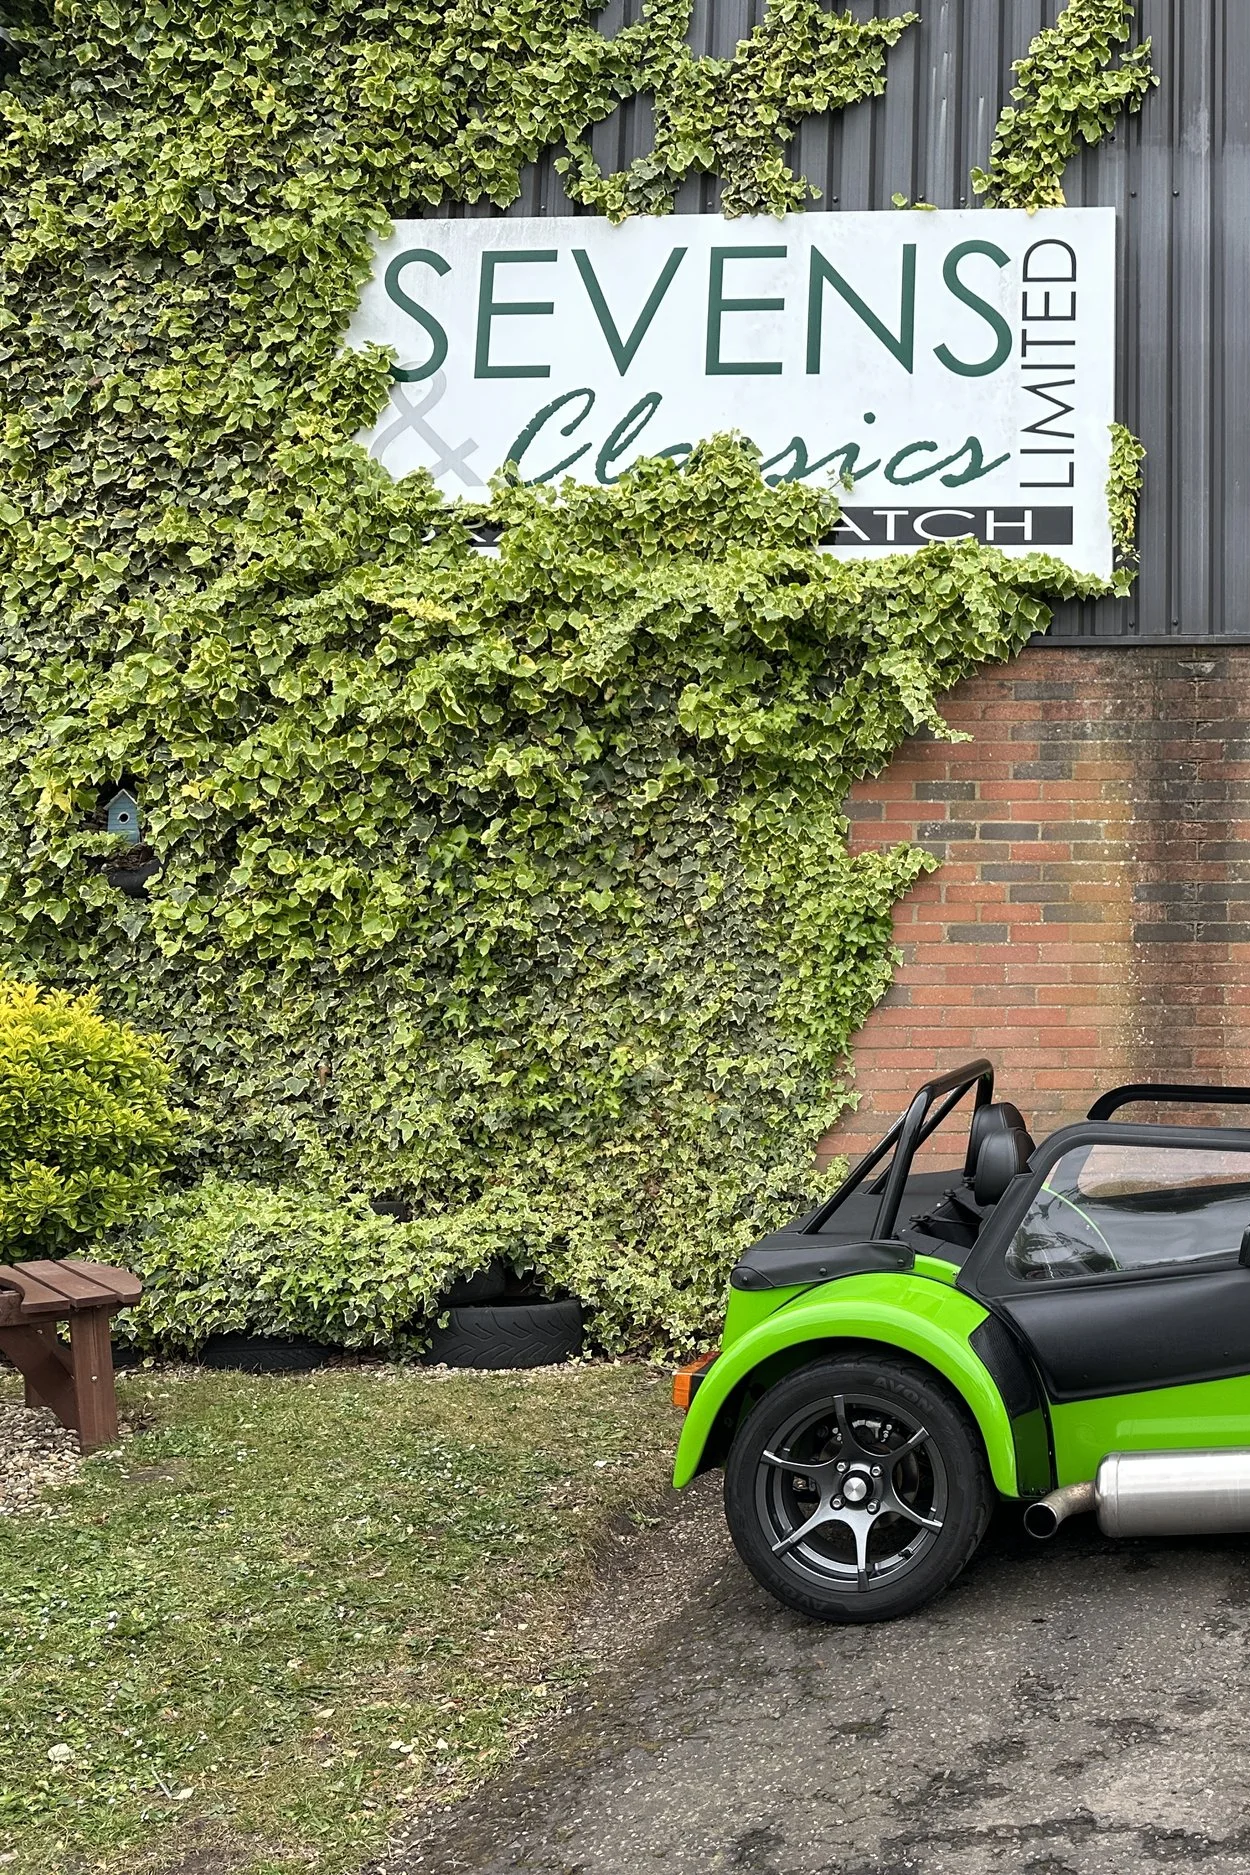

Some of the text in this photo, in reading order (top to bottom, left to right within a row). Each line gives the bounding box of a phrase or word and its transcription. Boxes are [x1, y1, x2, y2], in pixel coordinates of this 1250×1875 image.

[384, 240, 1013, 382] SEVENS
[1020, 238, 1077, 488] LIMITED
[505, 387, 1012, 487] Clsics
[829, 509, 1033, 541] ATCH
[872, 1376, 936, 1414] AVON
